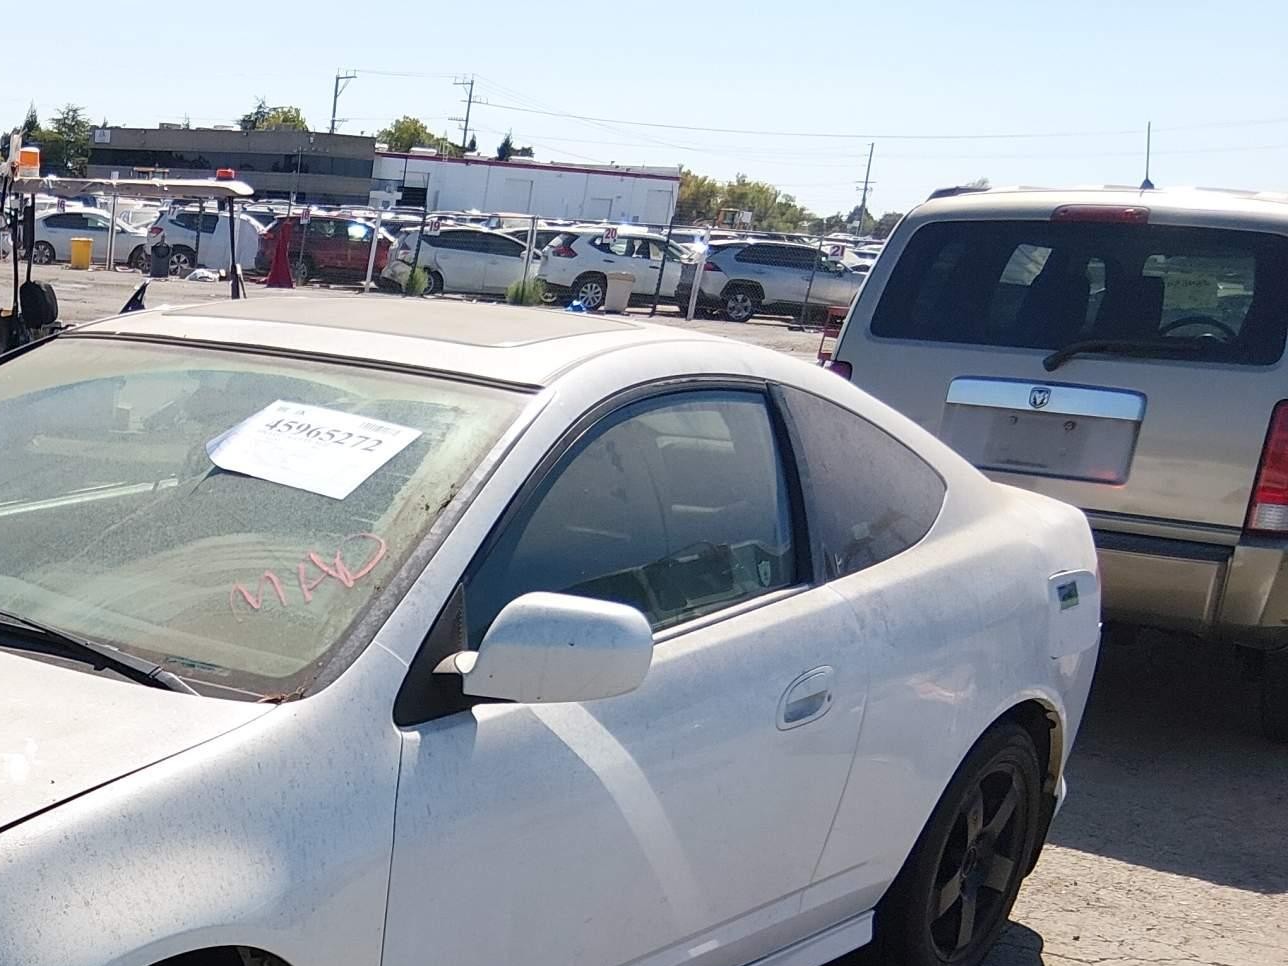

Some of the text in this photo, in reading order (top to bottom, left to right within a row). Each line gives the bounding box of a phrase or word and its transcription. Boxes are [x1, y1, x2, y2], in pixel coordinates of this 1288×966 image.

[429, 219, 441, 232] 19
[604, 227, 618, 240] 20
[829, 244, 846, 257] 21
[265, 418, 383, 452] 45965272
